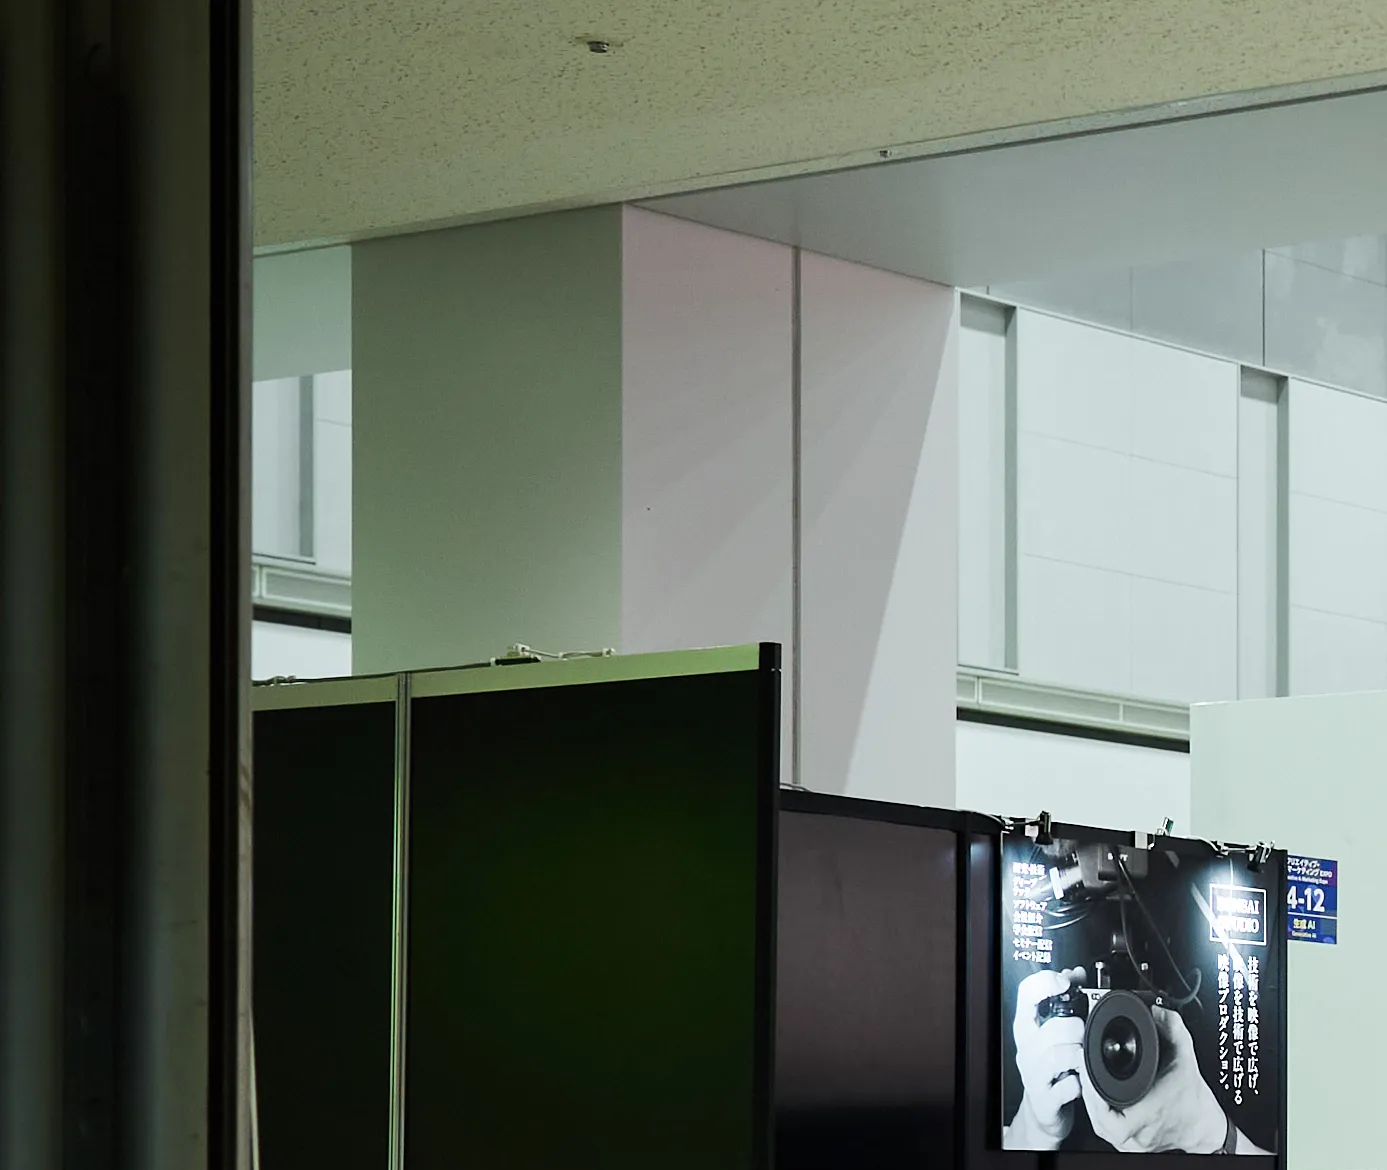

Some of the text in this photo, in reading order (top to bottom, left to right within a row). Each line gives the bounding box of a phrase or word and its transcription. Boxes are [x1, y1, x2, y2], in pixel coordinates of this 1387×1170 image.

[1217, 954, 1230, 1090] 映像プロダクション。
